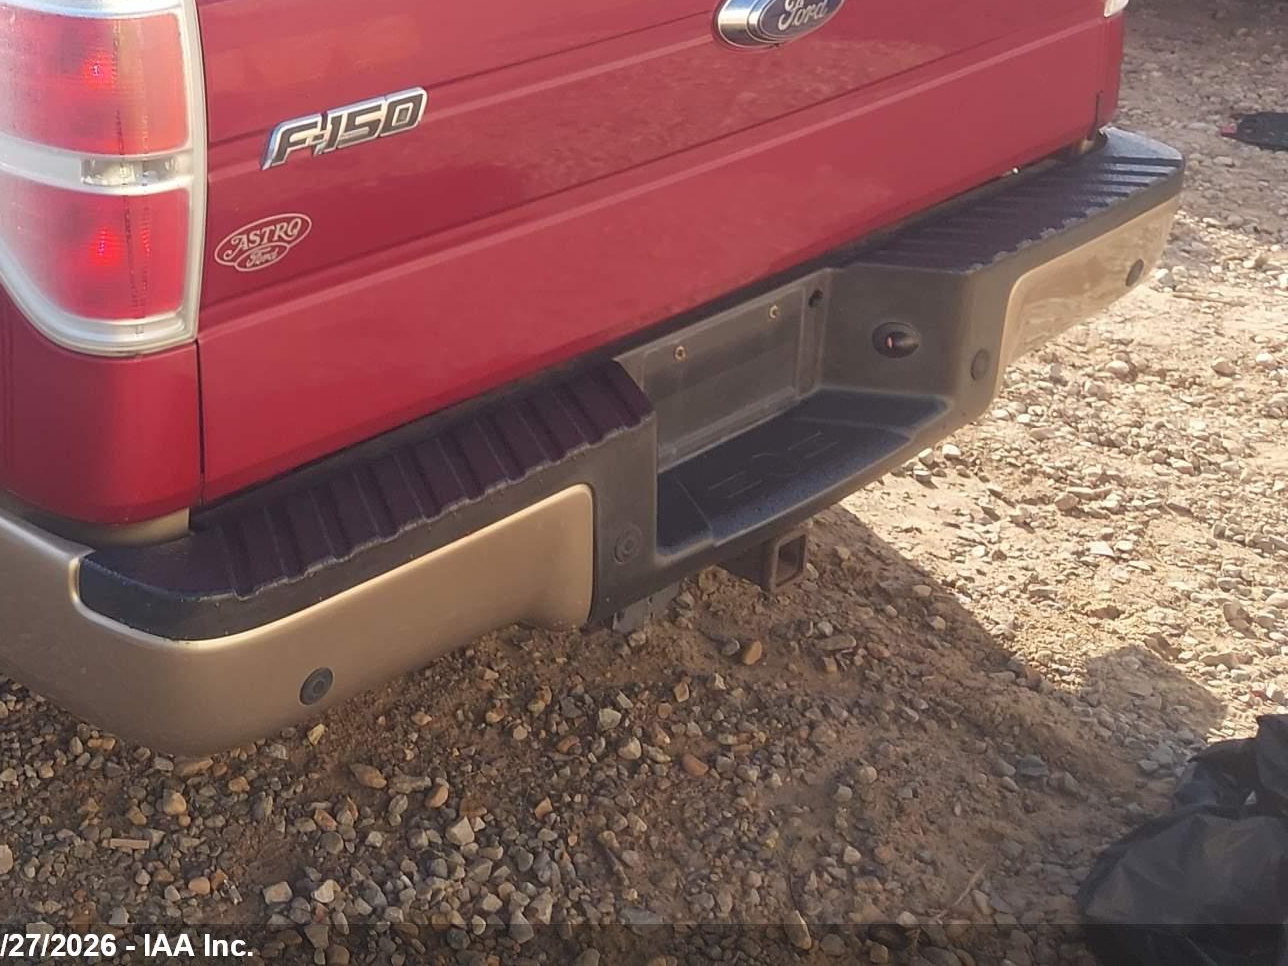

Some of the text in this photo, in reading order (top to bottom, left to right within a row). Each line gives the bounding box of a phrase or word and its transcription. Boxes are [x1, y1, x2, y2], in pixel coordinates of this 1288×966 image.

[261, 86, 428, 171] F-150
[223, 218, 302, 261] ASTRO
[245, 246, 281, 268] Ford
